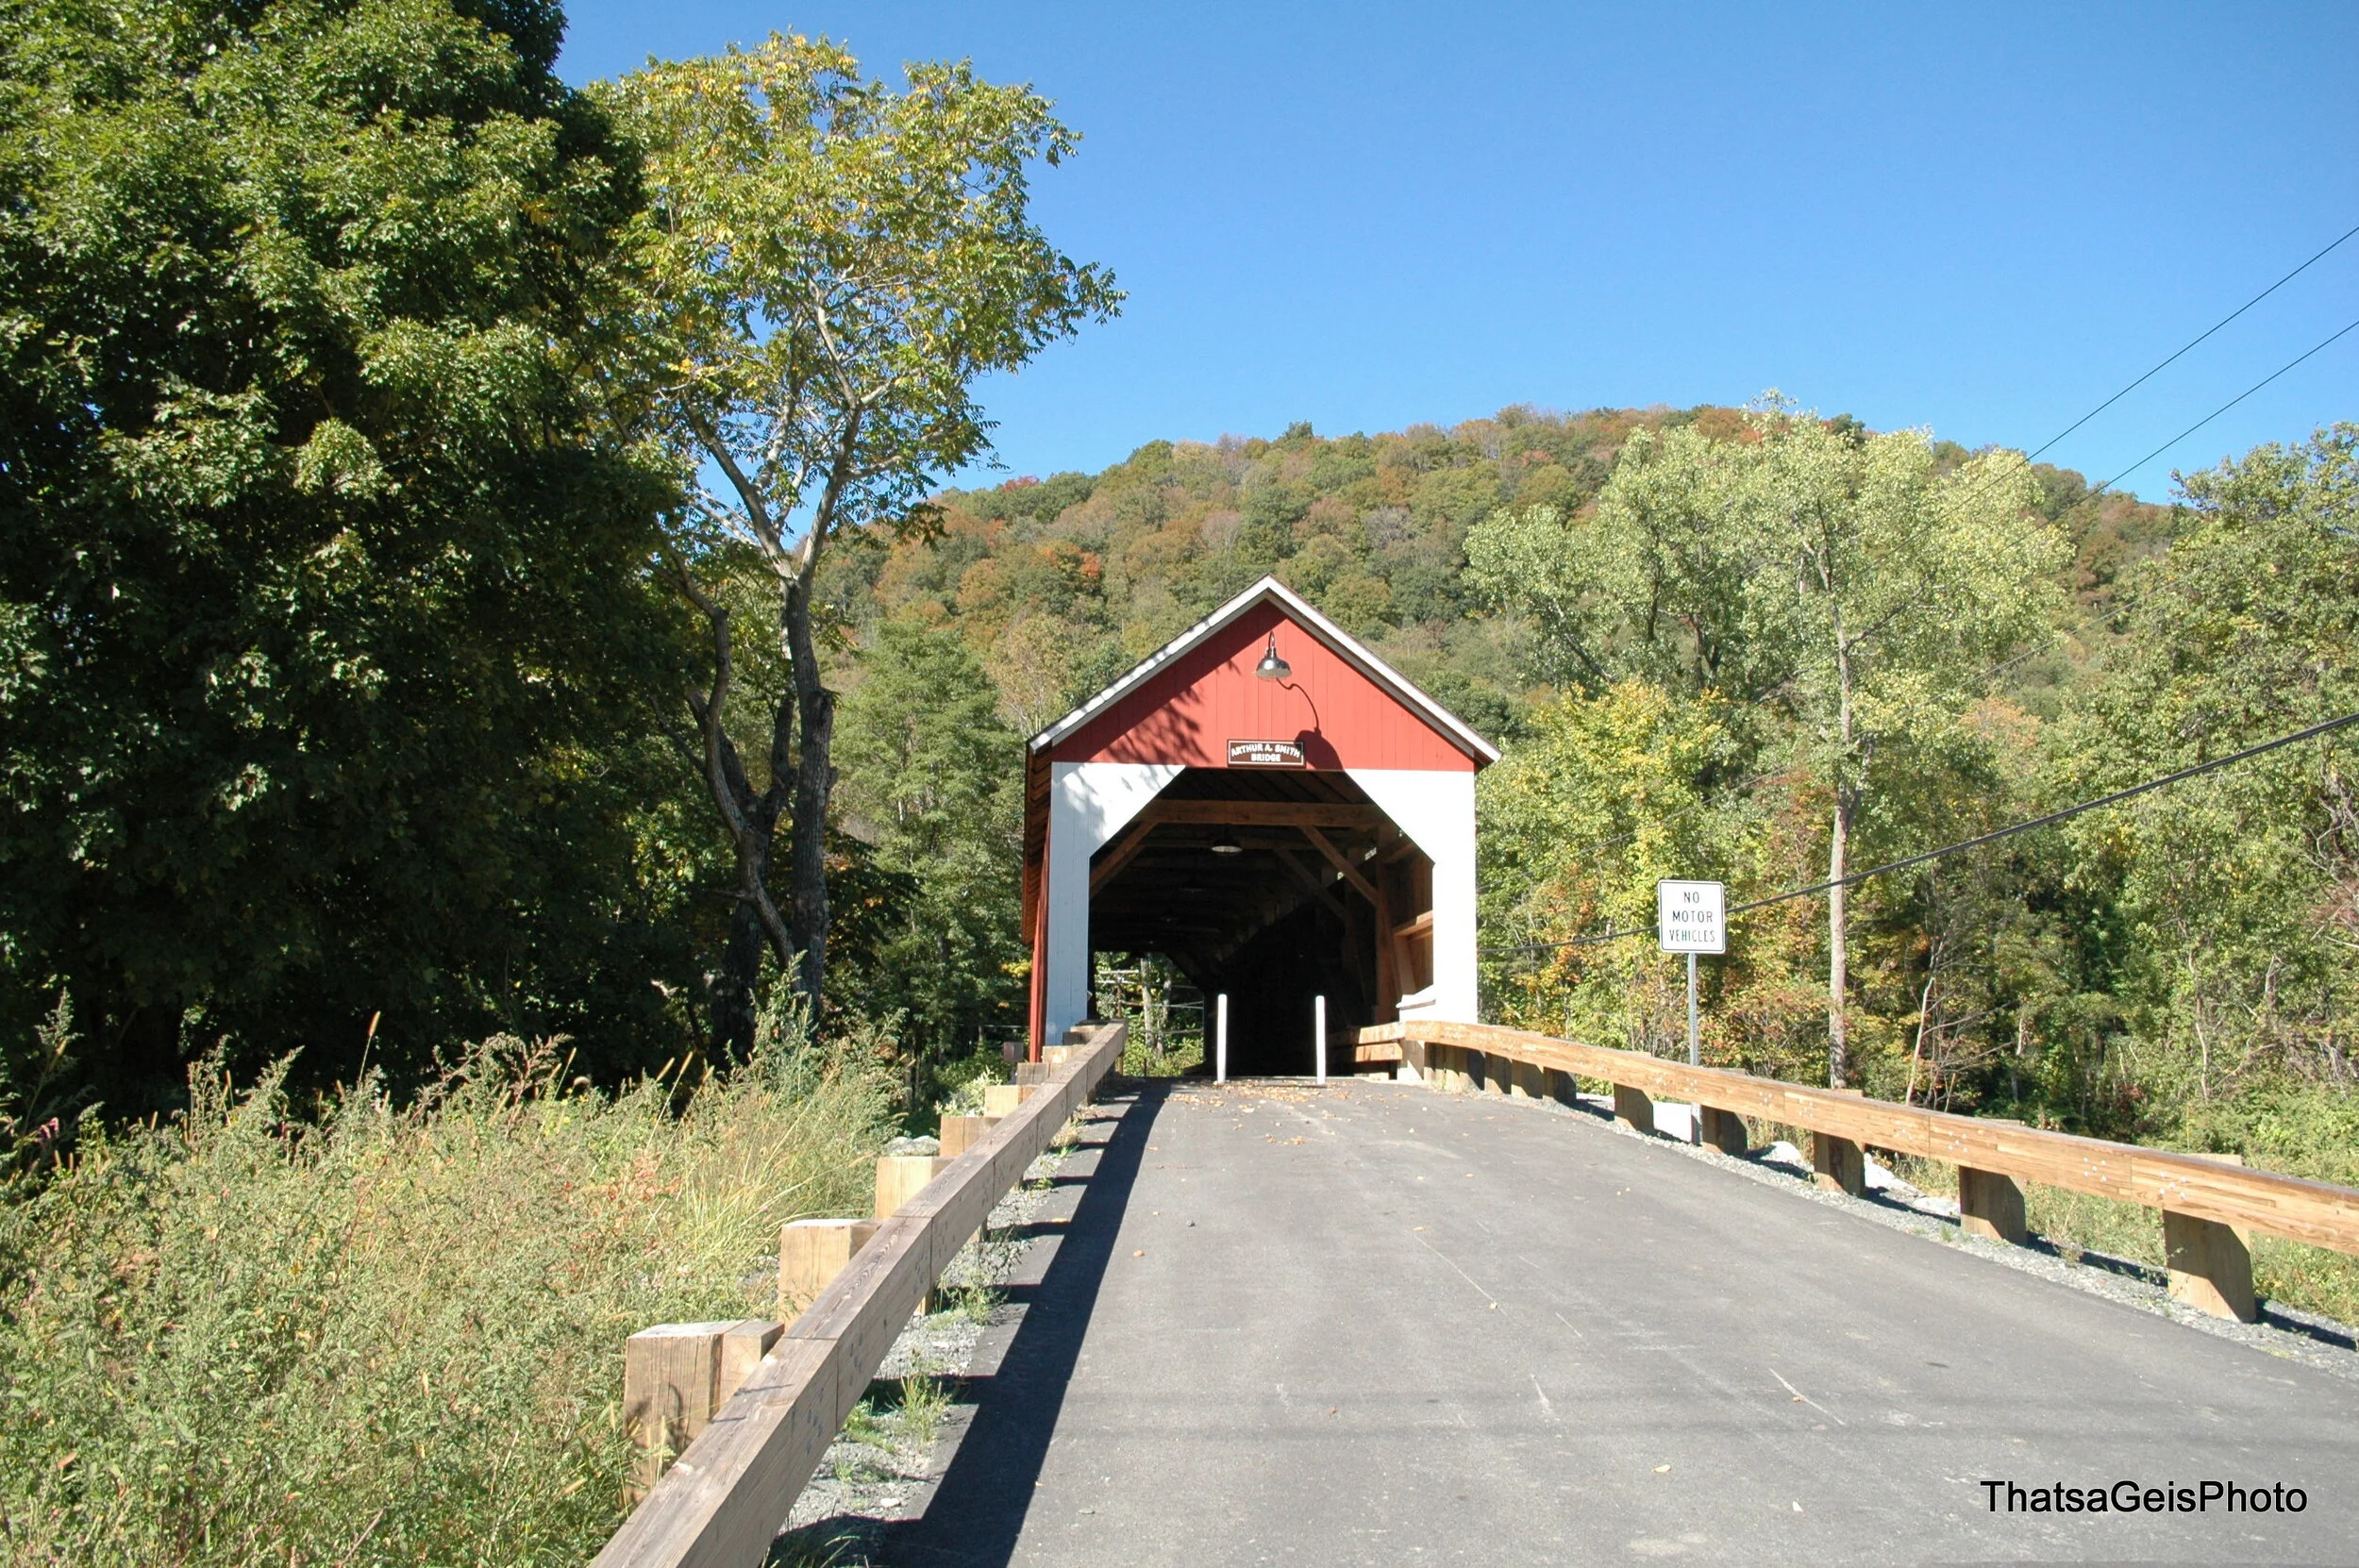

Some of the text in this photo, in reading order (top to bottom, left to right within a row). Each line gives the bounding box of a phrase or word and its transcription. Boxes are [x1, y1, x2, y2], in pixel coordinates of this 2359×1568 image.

[1230, 743, 1300, 758] ARTHUR A. SMITH
[1250, 753, 1280, 761] BRIDGE
[1683, 891, 1699, 904] NO
[1672, 909, 1713, 923] MOTOR
[1668, 929, 1715, 942] VEHICLES
